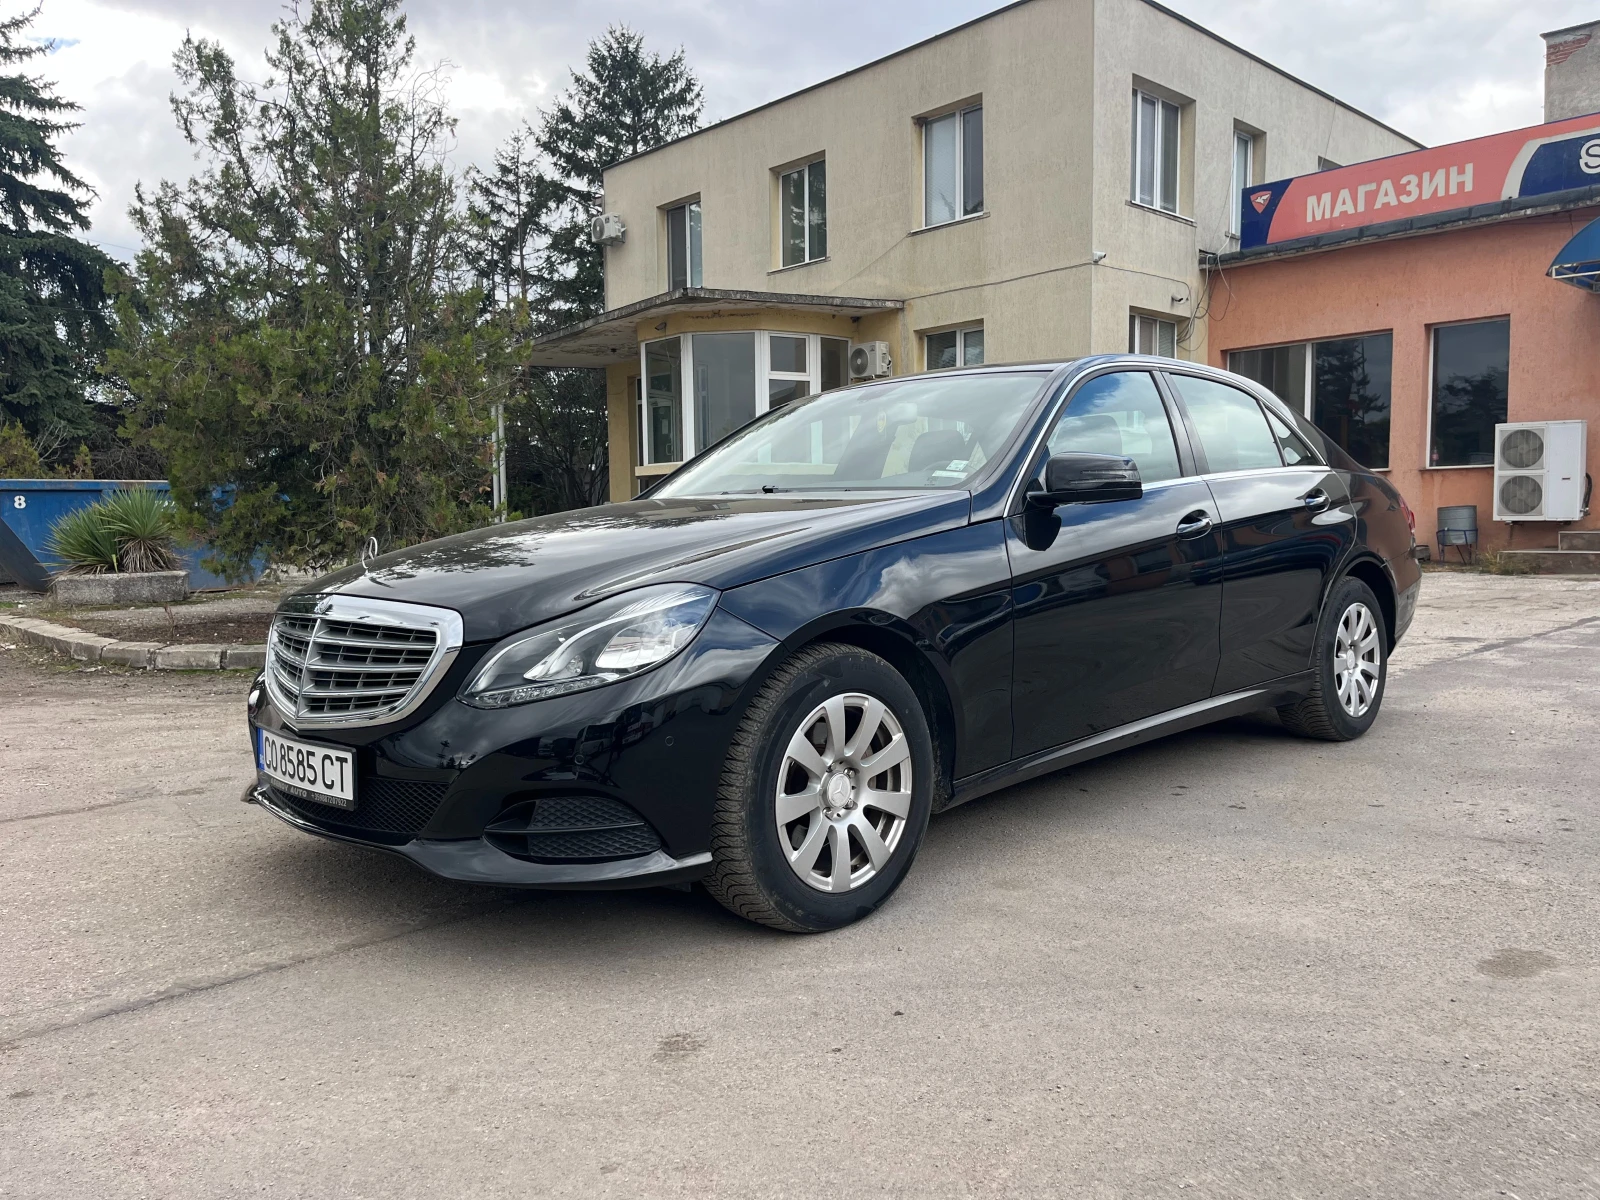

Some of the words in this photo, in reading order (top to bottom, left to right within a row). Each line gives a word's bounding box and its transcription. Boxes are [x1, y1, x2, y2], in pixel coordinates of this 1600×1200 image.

[1306, 163, 1474, 223] МАГАЗИН
[14, 495, 26, 509] 8
[290, 785, 308, 798] AUTO
